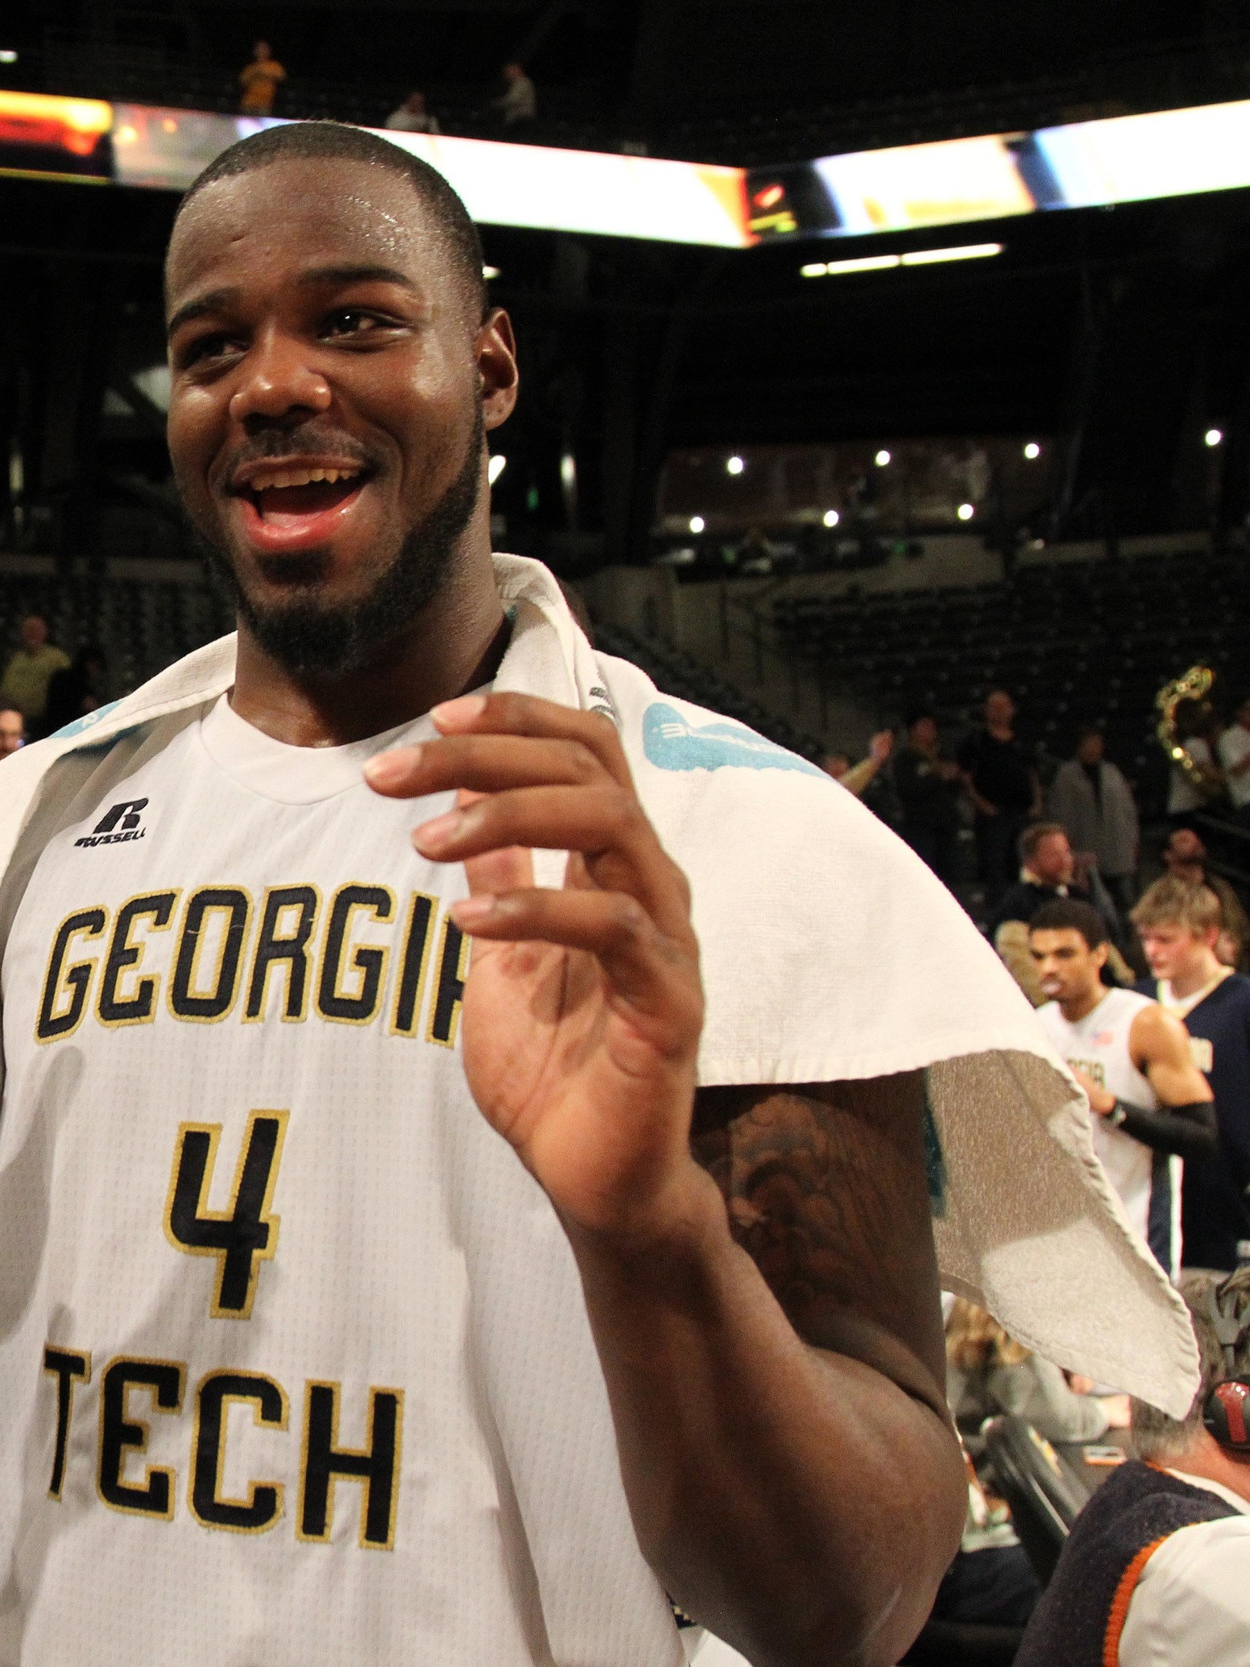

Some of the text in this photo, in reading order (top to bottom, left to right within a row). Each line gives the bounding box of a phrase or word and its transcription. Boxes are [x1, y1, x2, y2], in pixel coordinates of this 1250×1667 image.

[74, 827, 146, 848] RUSSELL
[92, 797, 149, 834] R
[163, 1109, 290, 1319] 4
[44, 1344, 405, 1551] TECH
